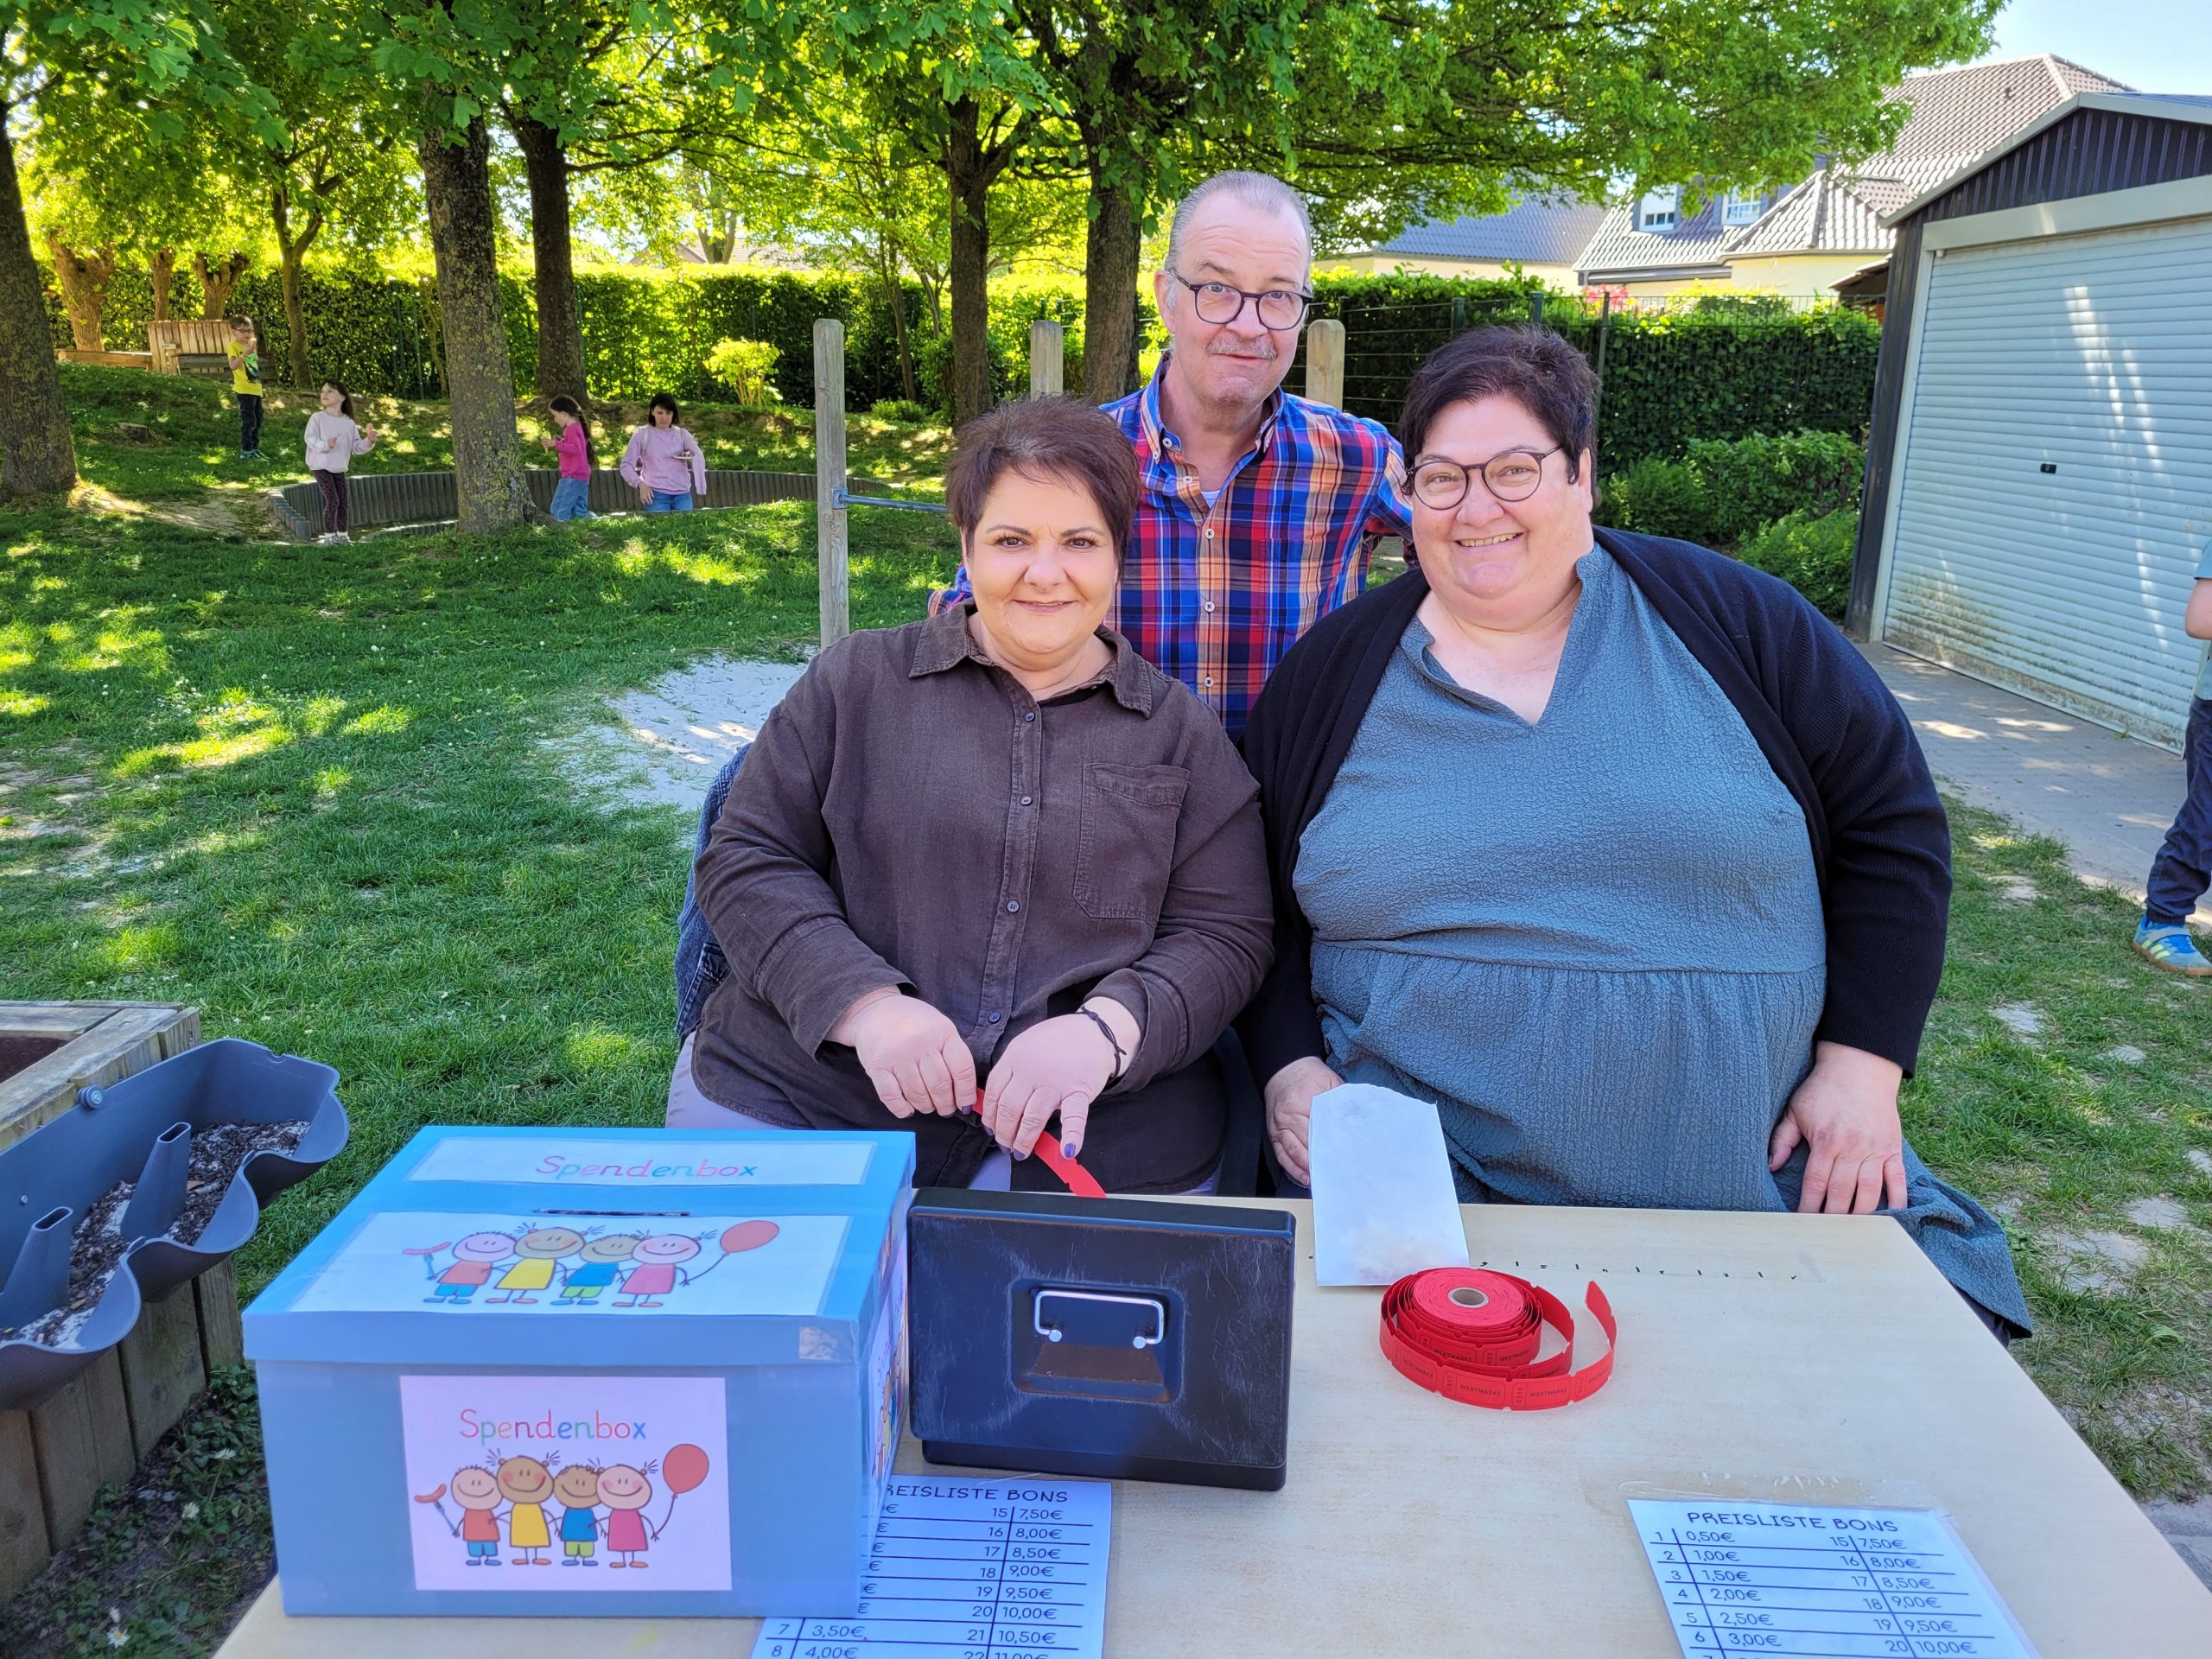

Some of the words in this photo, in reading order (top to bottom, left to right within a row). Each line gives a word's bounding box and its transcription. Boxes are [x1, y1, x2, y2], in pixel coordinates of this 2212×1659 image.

[536, 1155, 758, 1180] Spendenbox
[1433, 1348, 1473, 1363] WERTMARKE
[1459, 1382, 1502, 1397] WERTMARKE
[1529, 1387, 1567, 1398] WERTMARKE
[460, 1408, 647, 1447] Spendenbox
[887, 1484, 1000, 1501] REISLISTE
[1007, 1489, 1068, 1503] BONS
[991, 1507, 1008, 1518] 15
[1019, 1508, 1064, 1521] 7,50€
[1687, 1512, 1827, 1529] PREISLISTE
[1832, 1518, 1899, 1533] BONS
[988, 1526, 1004, 1537] 16
[1015, 1527, 1063, 1540] 8,00€
[1655, 1531, 1664, 1542] 1
[1686, 1530, 1736, 1543] 0,50€
[1829, 1536, 1850, 1548] 15
[1857, 1537, 1908, 1550] 7,50€
[983, 1546, 1001, 1557] 17
[1011, 1547, 1062, 1560] 8,50€
[1662, 1550, 1675, 1561] 2
[1693, 1549, 1741, 1562] 1,00€
[1840, 1556, 1860, 1567] 16
[1870, 1556, 1922, 1569] 8,00€
[980, 1567, 996, 1579] 18
[1008, 1565, 1055, 1578] 9,00€
[1670, 1570, 1682, 1580] 3
[1701, 1569, 1752, 1583] 1,50€
[1850, 1575, 1868, 1587] 17
[1881, 1576, 1936, 1590] 8,50€
[976, 1586, 994, 1598] 19
[1005, 1586, 1054, 1600] 9,50€
[1677, 1588, 1688, 1599] 4
[1709, 1587, 1763, 1602] 2,00€
[1862, 1598, 1884, 1611] 18
[1891, 1595, 1942, 1609] 9,00€
[971, 1605, 994, 1618] 20
[1002, 1606, 1058, 1620] 10,00€
[1686, 1611, 1699, 1624] 5
[1719, 1611, 1775, 1626] 2,50€
[779, 1623, 791, 1636] 7
[811, 1624, 866, 1639] 3,50€
[1872, 1618, 1892, 1631] 19
[1904, 1619, 1959, 1634] 9,50€
[966, 1629, 985, 1642] 21
[998, 1630, 1058, 1645] 10,50€
[1694, 1630, 1707, 1643] 6
[1728, 1632, 1782, 1648] 3,00€
[771, 1644, 783, 1658] 8
[1885, 1639, 1910, 1653] 20
[1915, 1641, 1978, 1656] 10,00€
